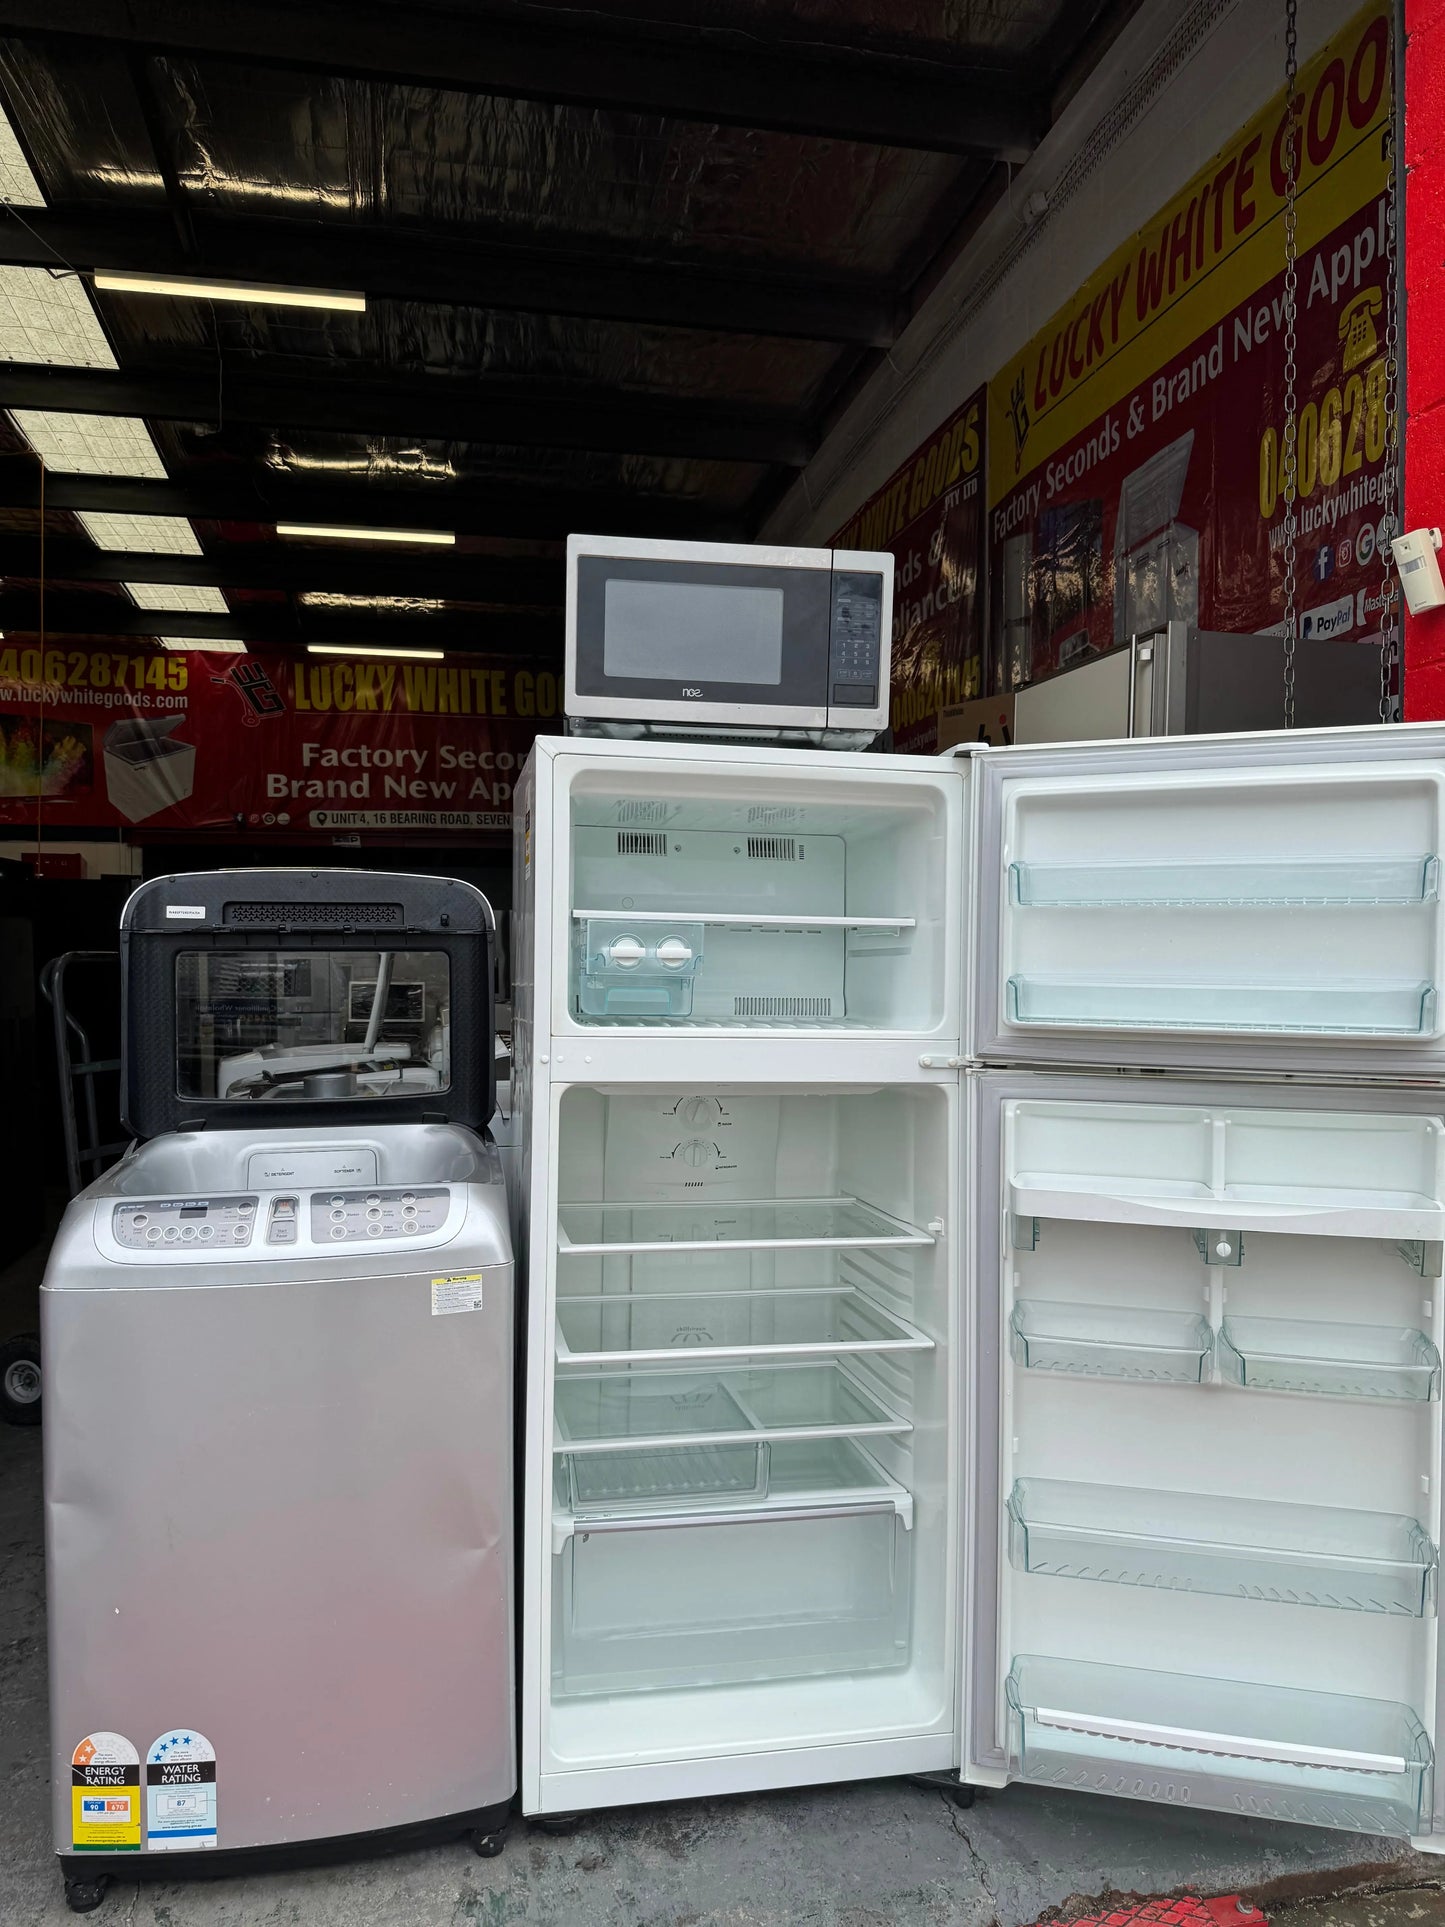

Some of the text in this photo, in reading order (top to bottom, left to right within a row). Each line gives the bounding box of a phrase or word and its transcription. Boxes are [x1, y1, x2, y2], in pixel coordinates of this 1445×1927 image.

[1034, 262, 1131, 411] LUCKY
[1136, 133, 1262, 322] WHITE
[993, 479, 1041, 545] Factory
[1046, 414, 1120, 499] Seconds
[1127, 395, 1145, 439] &
[1152, 325, 1223, 422] Brand
[1233, 289, 1296, 362] New
[1259, 358, 1397, 518] 040628
[907, 402, 979, 521] GOODS
[1316, 609, 1351, 633] PayPal
[0, 648, 189, 692] 406287145
[294, 661, 397, 712] LUCKY
[403, 665, 508, 716] WHITE
[302, 742, 429, 774] Factory
[266, 772, 513, 806] Brand New Ap
[331, 812, 358, 825] UNIT
[373, 812, 387, 825] 16
[390, 812, 437, 826] BEARING
[476, 814, 510, 826] SEVEN
[85, 1766, 126, 1776] ENERGY
[86, 1776, 125, 1785] RATING
[161, 1773, 201, 1784] RATING
[163, 1764, 200, 1774] WATER
[176, 1799, 186, 1807] 87
